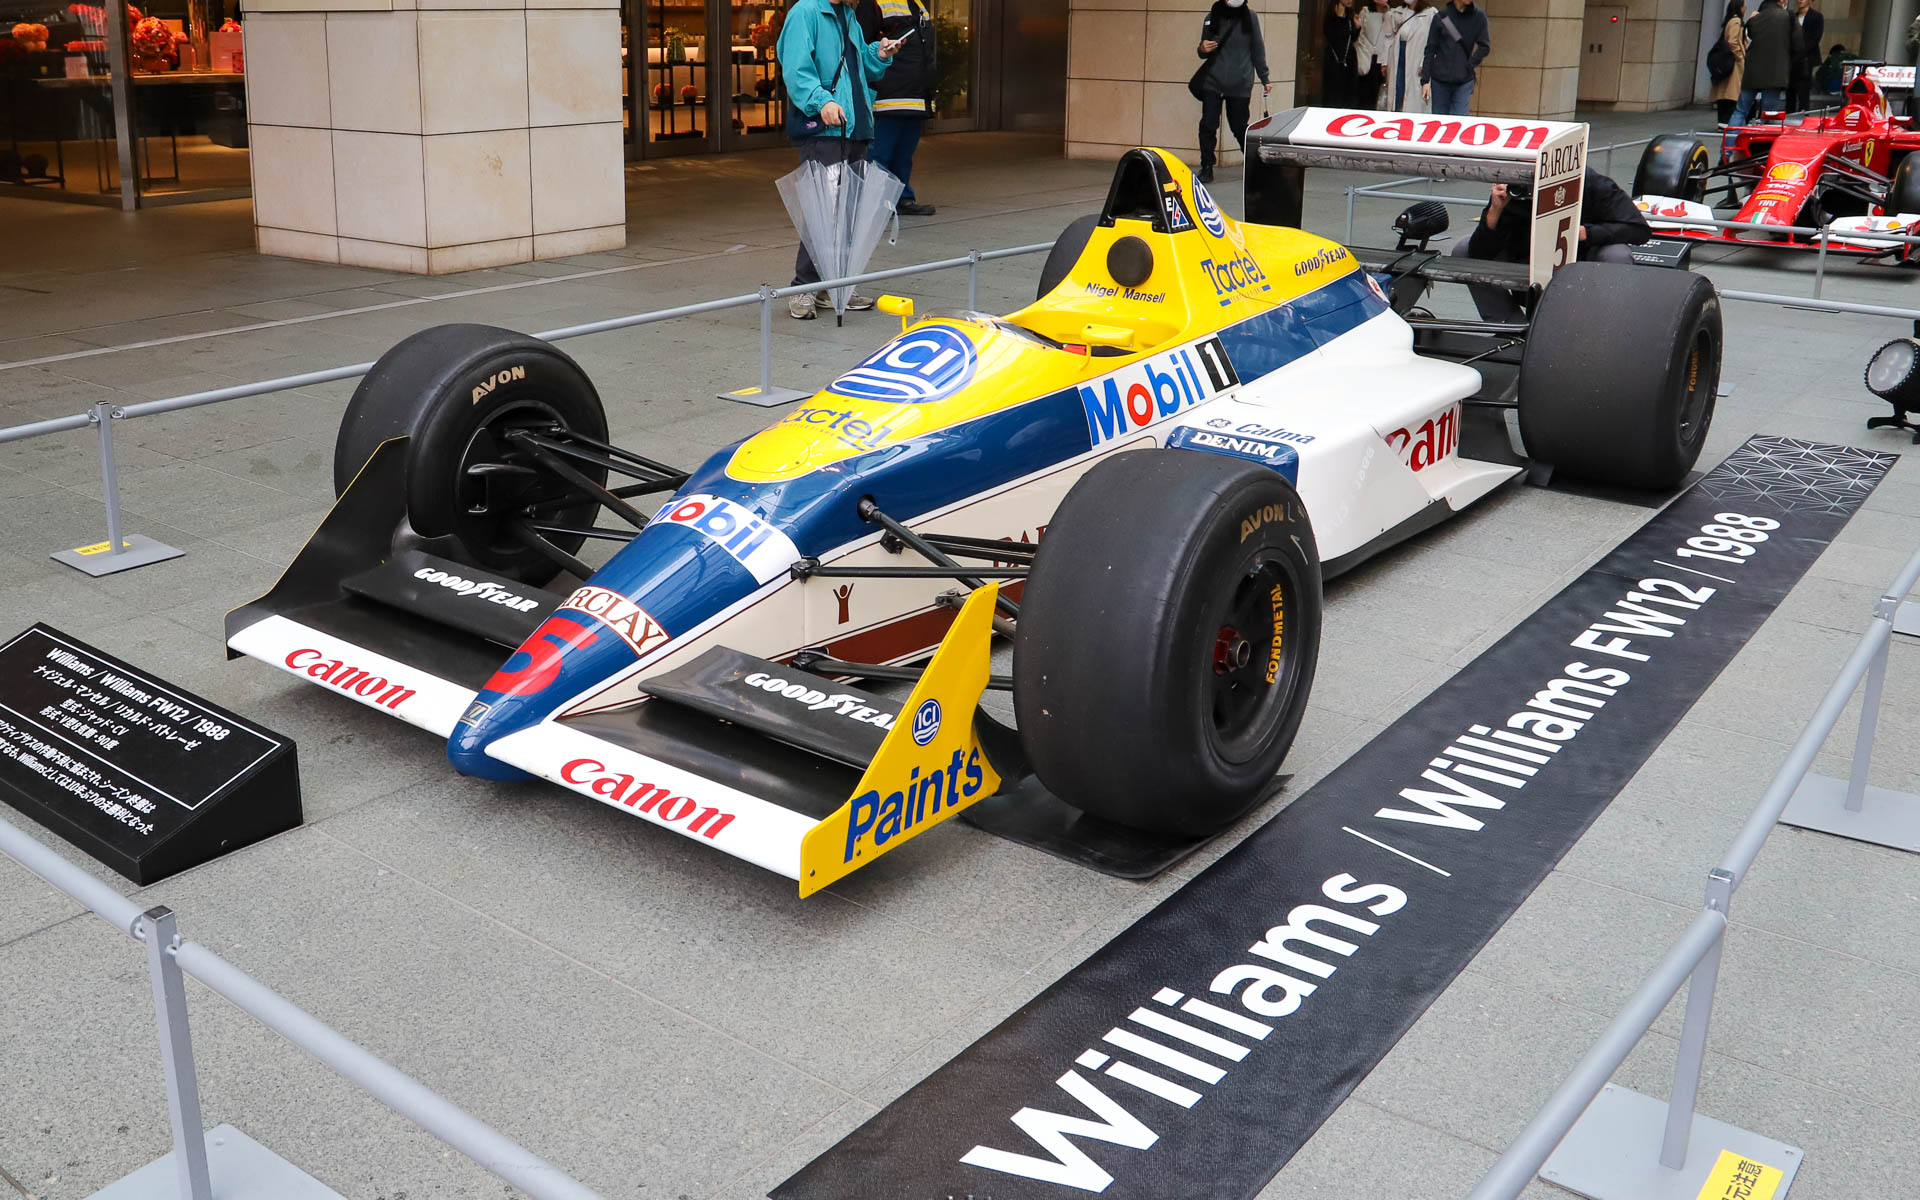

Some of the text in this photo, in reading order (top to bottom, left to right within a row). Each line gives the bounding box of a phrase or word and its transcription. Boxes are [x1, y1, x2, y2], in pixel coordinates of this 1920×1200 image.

[1326, 114, 1549, 149] Canon
[1539, 138, 1584, 180] BARCLAY
[1294, 247, 1348, 277] GOODYEAR
[1553, 216, 1571, 272] 5
[1084, 282, 1166, 304] Nigel Mansell
[1200, 249, 1266, 295] Tactel
[863, 339, 961, 376] ICI
[472, 365, 526, 406] AVON
[1080, 341, 1231, 447] Mobil 1
[782, 408, 892, 448] actel
[1190, 432, 1280, 458] DENIM
[1235, 423, 1316, 444] Calma
[643, 497, 775, 561] Mobil
[1241, 504, 1284, 544] AVON
[413, 567, 539, 613] GOODYEAR
[560, 589, 664, 650] RCLAY
[1266, 583, 1283, 684] FONDMETAL
[285, 648, 417, 710] Canon
[483, 617, 600, 696] 5
[46, 647, 95, 677] Williams
[99, 673, 152, 704] Williams
[147, 697, 190, 722] FW12
[193, 718, 231, 741] 1988
[918, 705, 937, 729] ICI
[560, 758, 736, 841] Canon
[844, 746, 983, 864] Paints
[959, 872, 1408, 1194] Williams
[1375, 661, 1632, 832] Williams
[1570, 577, 1717, 664] FW12
[1676, 512, 1781, 564] 1988
[1711, 1160, 1763, 1200] 元注意
